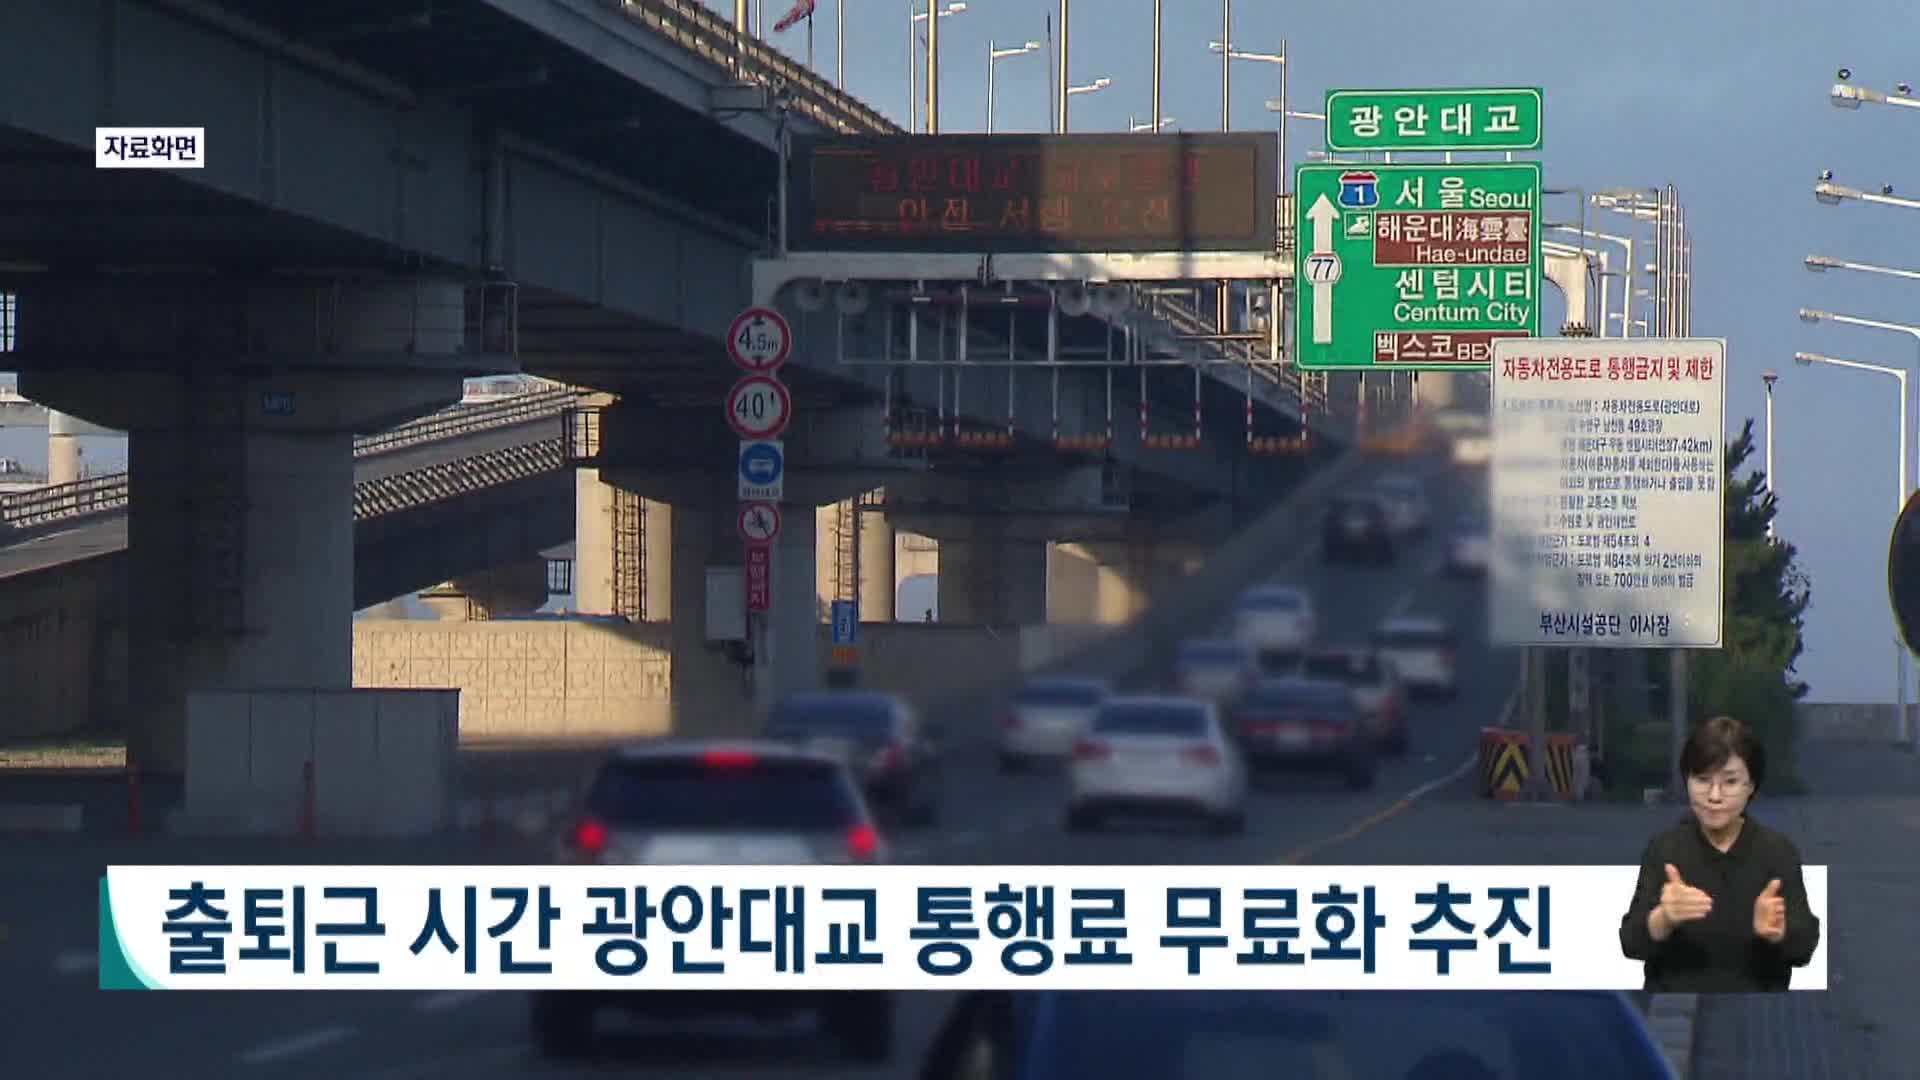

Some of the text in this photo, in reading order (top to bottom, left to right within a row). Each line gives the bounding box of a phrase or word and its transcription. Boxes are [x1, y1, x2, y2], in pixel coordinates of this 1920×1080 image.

[1349, 103, 1520, 137] 광안대교
[1353, 185, 1366, 204] 1
[1395, 176, 1467, 209] 서울
[1469, 187, 1533, 209] Seoul
[1377, 214, 1453, 243] 해운대
[1416, 244, 1527, 263] Hae-undae
[1311, 258, 1335, 280] 77
[1394, 268, 1531, 301] 센텀시티
[1393, 302, 1530, 326] Centum City
[1502, 356, 1714, 381] 자동차전용도로 통행금지 및 제한
[1539, 611, 1670, 637] 부산시설공단 이사장
